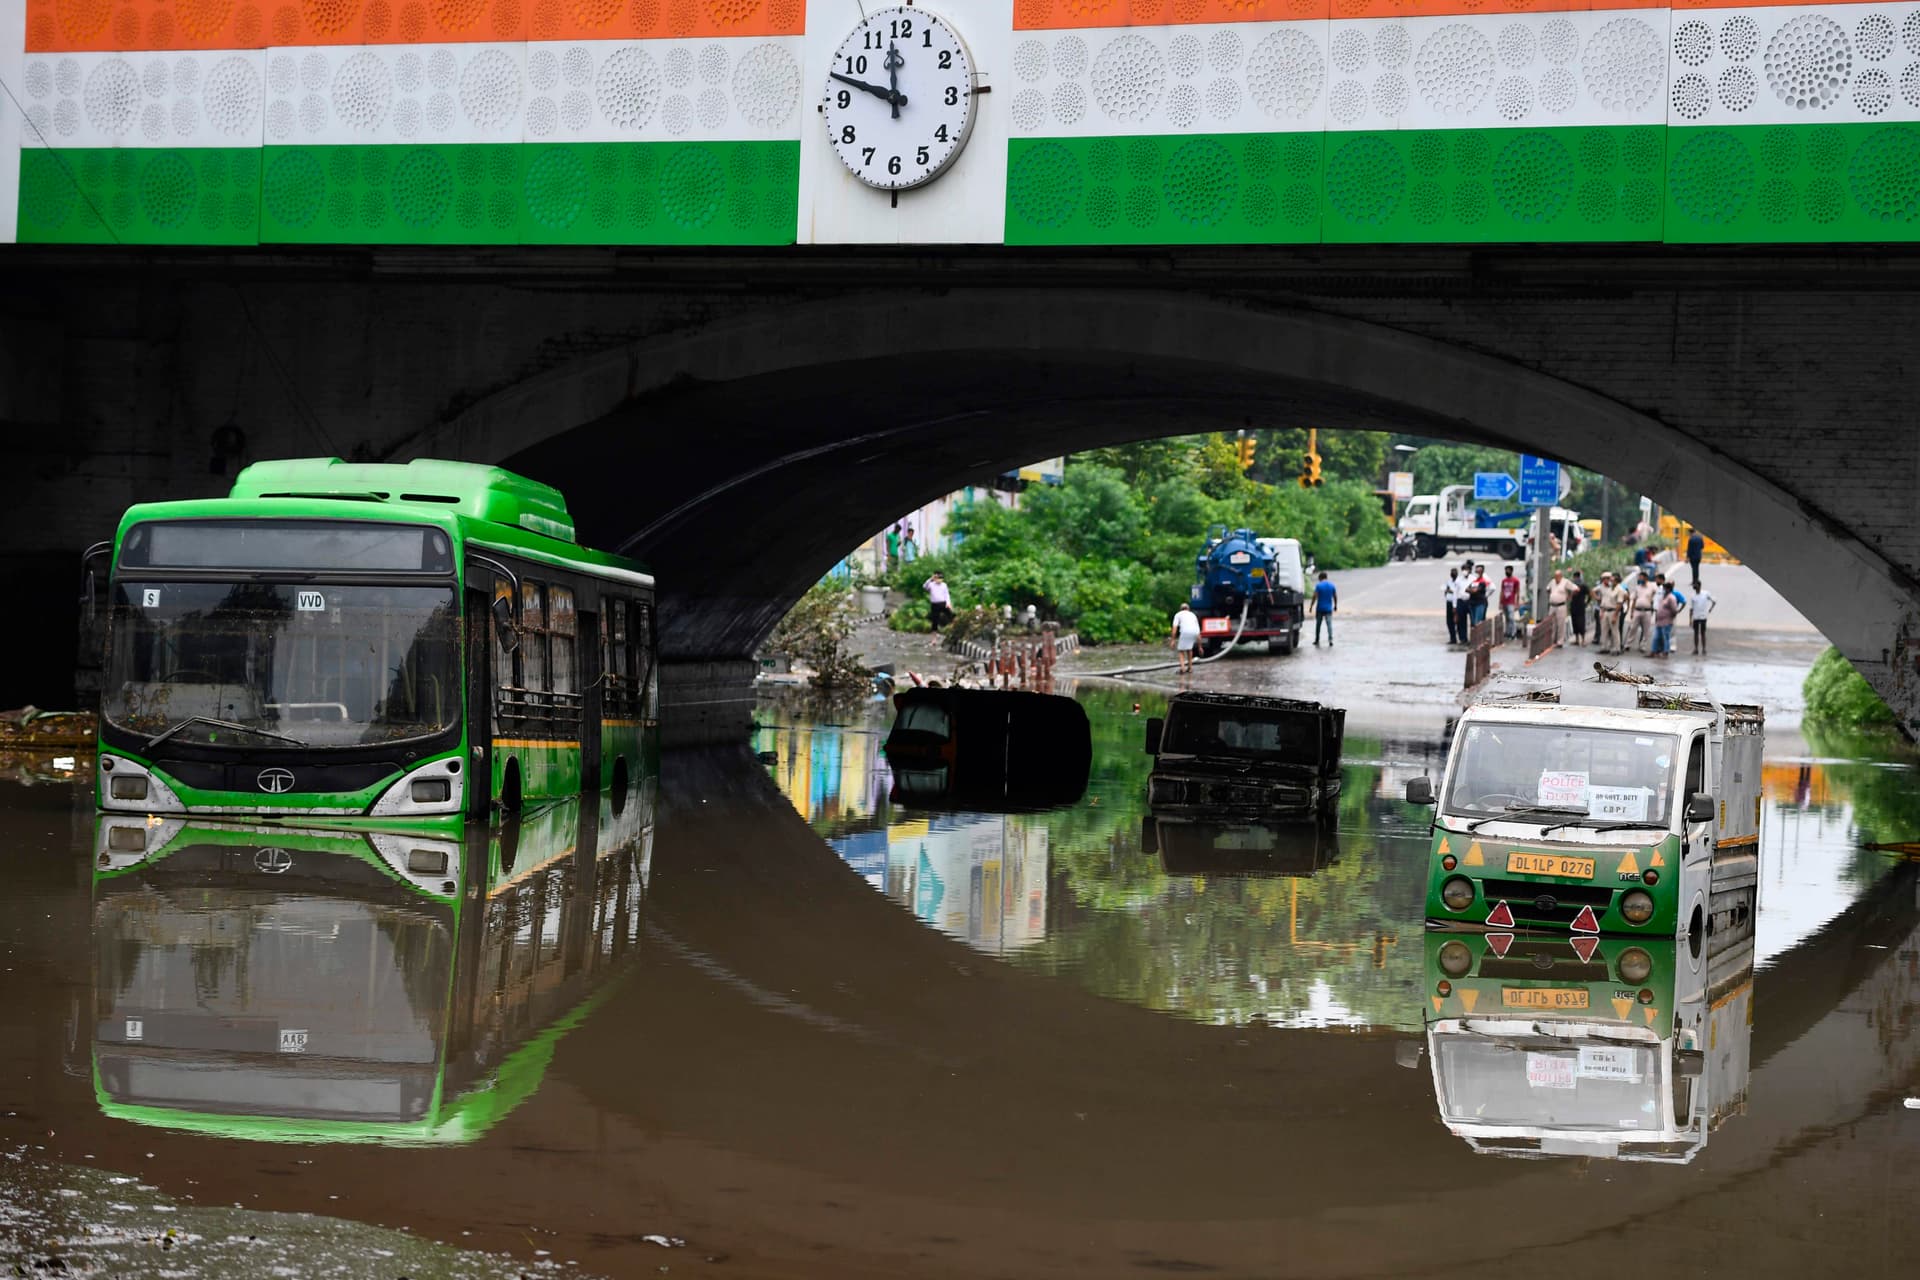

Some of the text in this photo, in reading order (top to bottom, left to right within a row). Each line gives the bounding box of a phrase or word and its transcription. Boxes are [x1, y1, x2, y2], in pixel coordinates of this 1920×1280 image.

[890, 19, 912, 38] 12
[922, 29, 932, 47] 1
[864, 31, 882, 49] 11
[845, 55, 867, 74] 10
[938, 50, 951, 69] 2
[837, 90, 851, 109] 9
[944, 86, 958, 105] 3
[841, 125, 856, 144] 8
[934, 124, 948, 143] 4
[862, 147, 876, 166] 7
[916, 146, 929, 165] 5
[888, 156, 901, 175] 6
[148, 592, 155, 606] S
[300, 594, 322, 607] VVD
[1543, 776, 1584, 787] POLICE
[1516, 857, 1592, 875] DL1LP 0276
